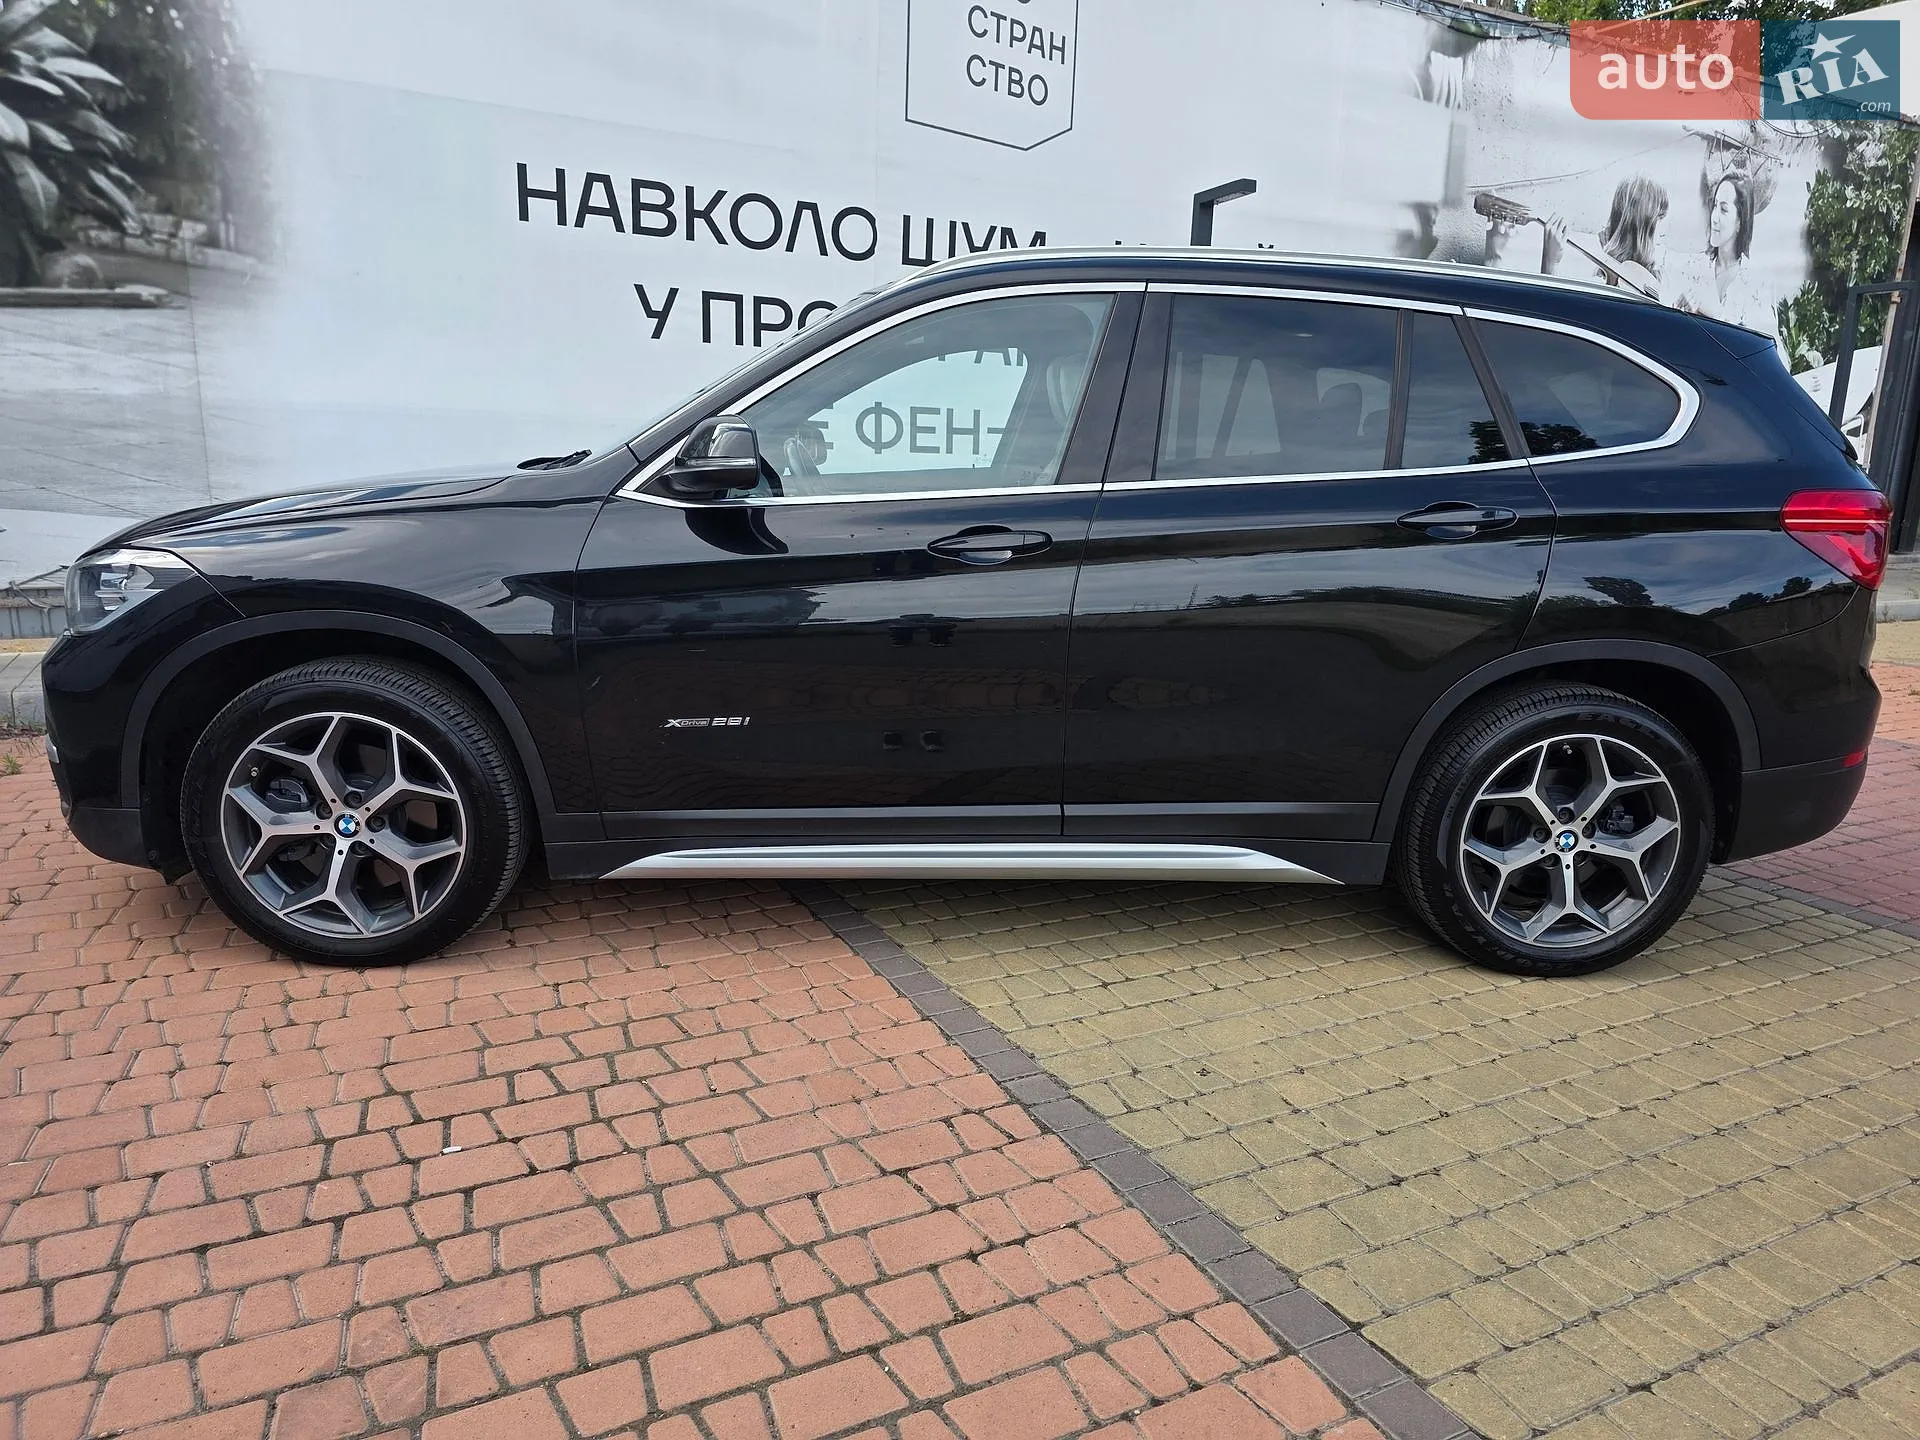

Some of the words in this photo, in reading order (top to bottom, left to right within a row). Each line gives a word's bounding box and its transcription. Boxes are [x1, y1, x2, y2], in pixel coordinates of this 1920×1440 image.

[967, 5, 1067, 65] СТРАН
[966, 54, 1049, 106] СТВО
[515, 162, 878, 261] НАВКОЛО
[633, 283, 680, 340] У
